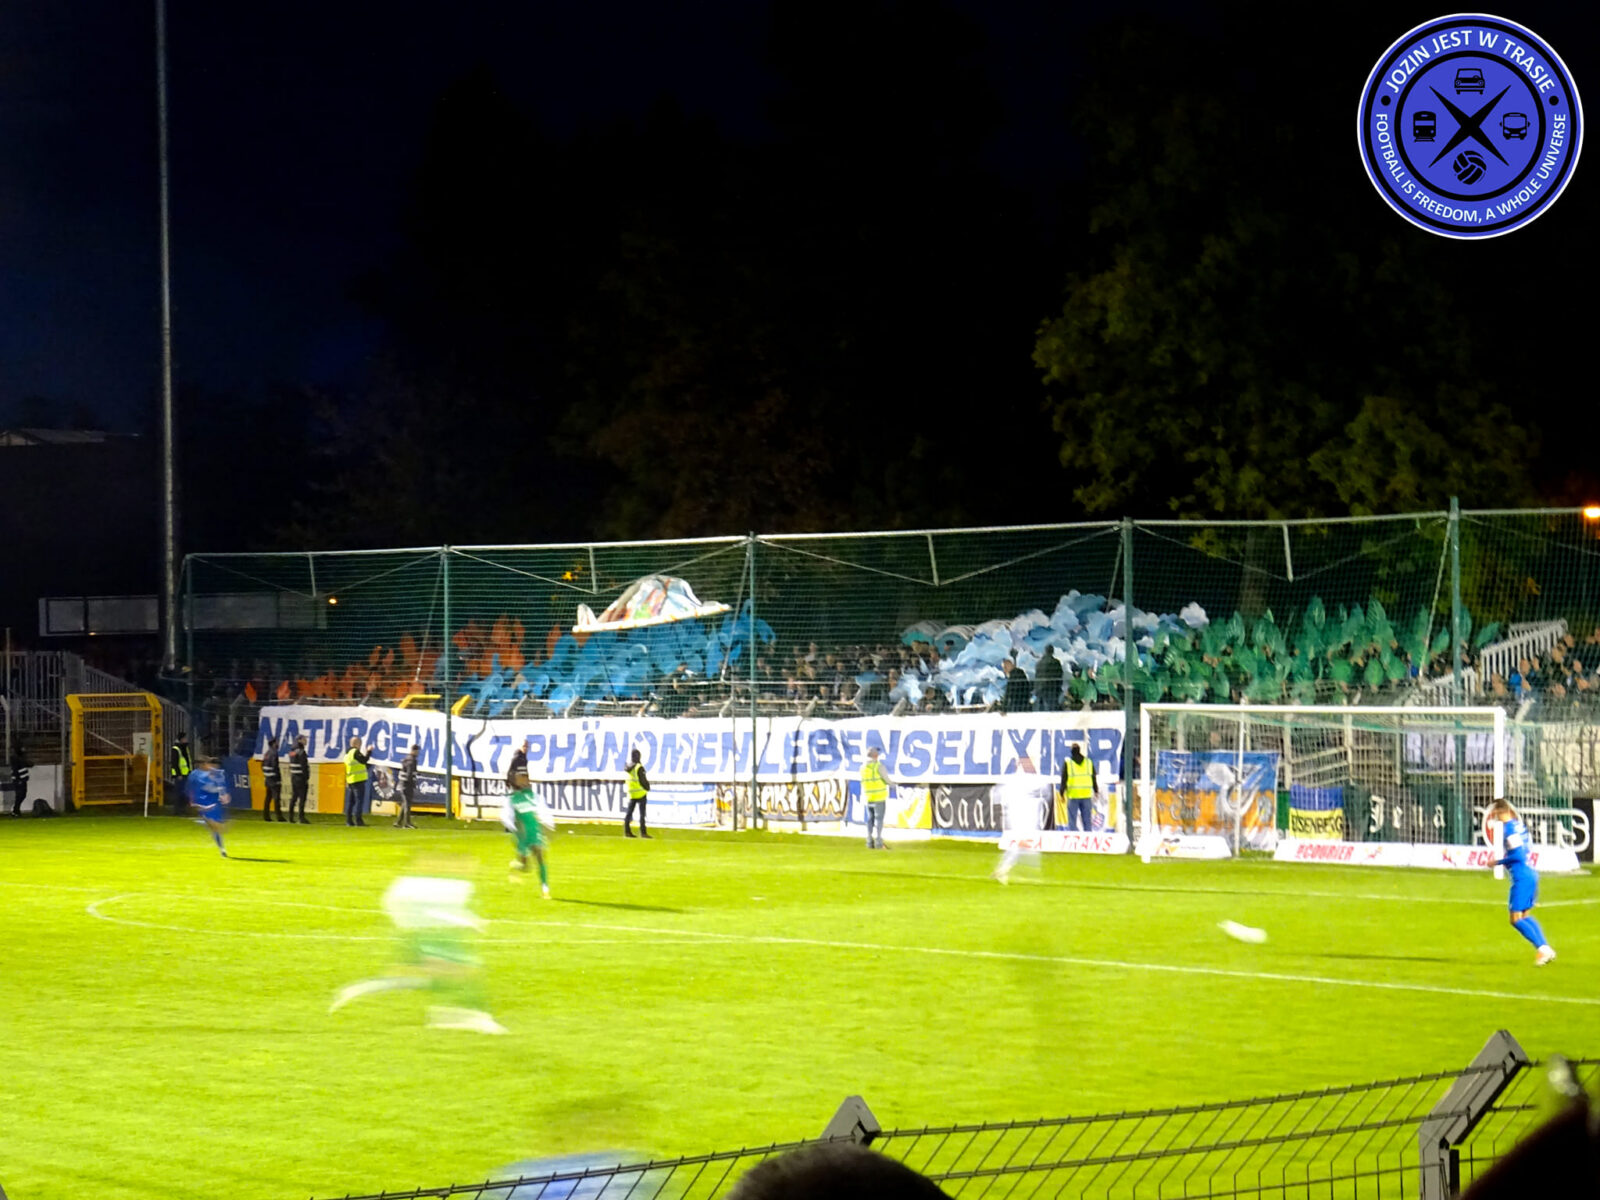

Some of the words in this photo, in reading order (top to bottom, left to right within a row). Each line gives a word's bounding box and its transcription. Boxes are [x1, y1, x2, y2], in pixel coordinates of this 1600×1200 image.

[254, 717, 512, 773] NATURGEWALT
[525, 720, 754, 774] PHÄNOMEN
[754, 728, 1124, 776] LEBENSELIXIER
[1061, 834, 1113, 852] TRANS
